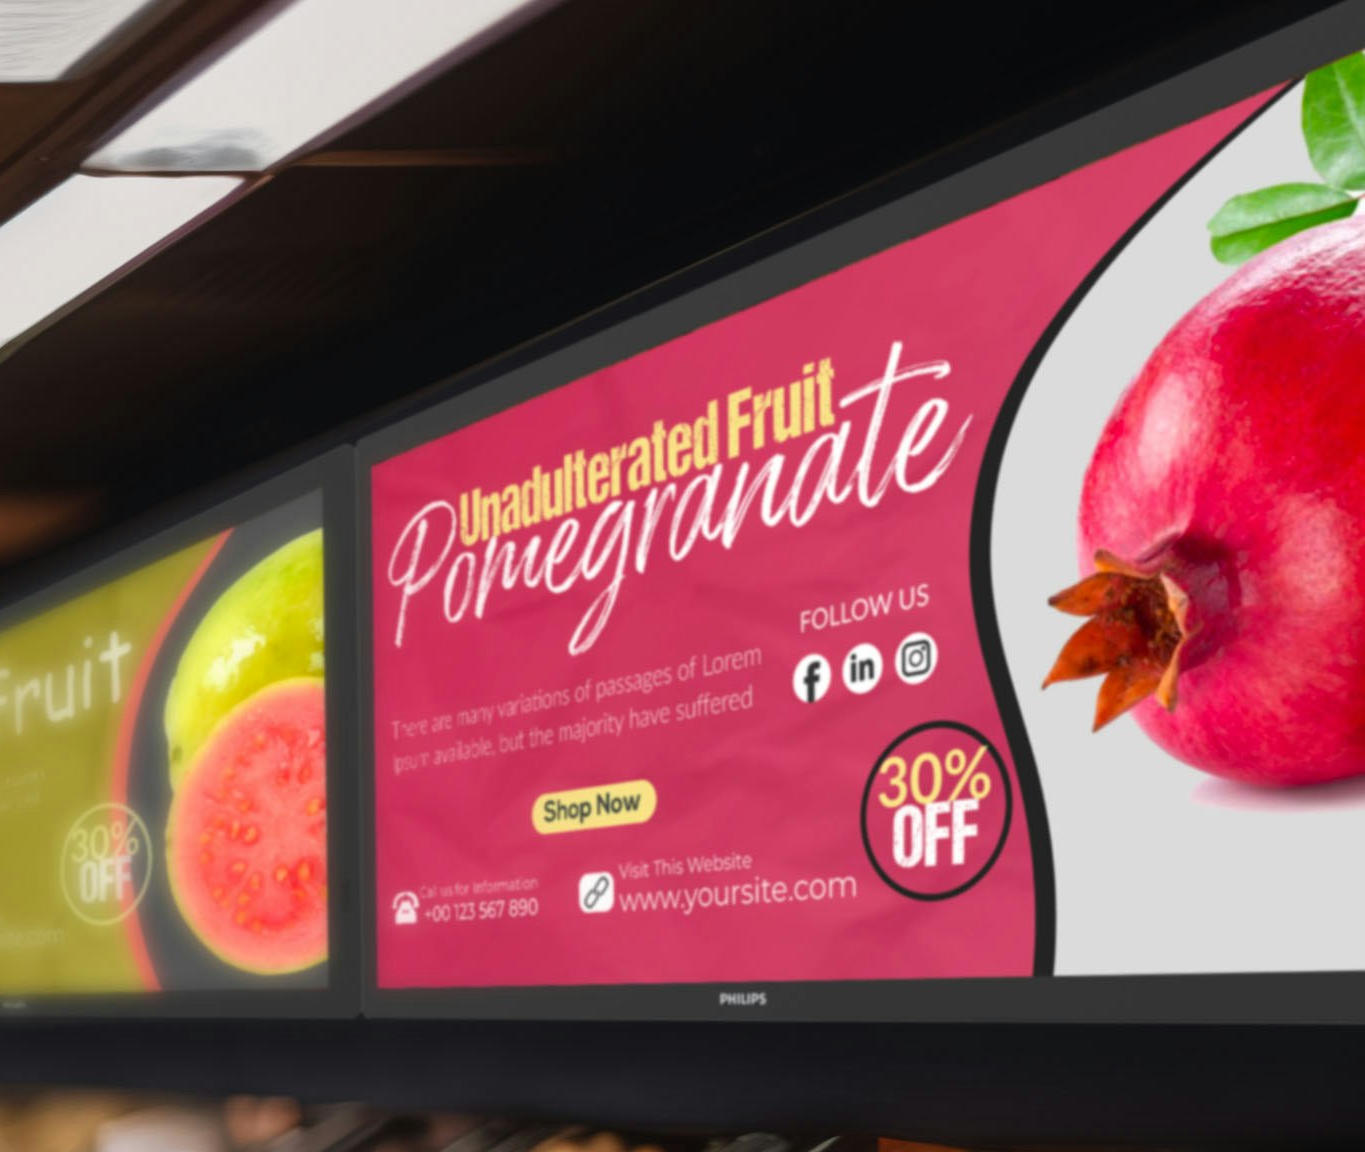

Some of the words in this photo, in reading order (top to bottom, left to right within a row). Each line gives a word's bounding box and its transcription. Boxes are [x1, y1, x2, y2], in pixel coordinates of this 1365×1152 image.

[459, 398, 719, 547] Unadulterated
[727, 357, 836, 460] Fruit
[387, 341, 974, 656] Pomegranate
[800, 591, 894, 633] FOLLOW
[899, 583, 930, 611] US
[431, 713, 454, 735] are
[457, 704, 496, 726] many
[497, 688, 571, 719] variations
[574, 678, 592, 703] of
[596, 665, 673, 703] passages
[677, 655, 698, 682] of
[702, 646, 762, 677] Lorem
[499, 730, 525, 753] but
[529, 725, 555, 748] the
[559, 711, 625, 744] majority
[629, 706, 671, 730] have
[675, 683, 754, 722] suffered
[878, 745, 991, 808] 30%
[543, 799, 592, 824] Shop
[596, 791, 641, 816] Now
[70, 816, 139, 863] 30%
[893, 798, 980, 868] OFF
[80, 855, 132, 904] OFF
[619, 861, 650, 880] Visit
[654, 858, 684, 877] This
[687, 853, 752, 875] Website
[424, 903, 451, 923] +00
[454, 901, 477, 921] 123
[479, 899, 505, 920] 567
[508, 896, 539, 918] 890
[619, 874, 858, 916] www.yoursite.com
[719, 991, 768, 1006] PHILIPS
